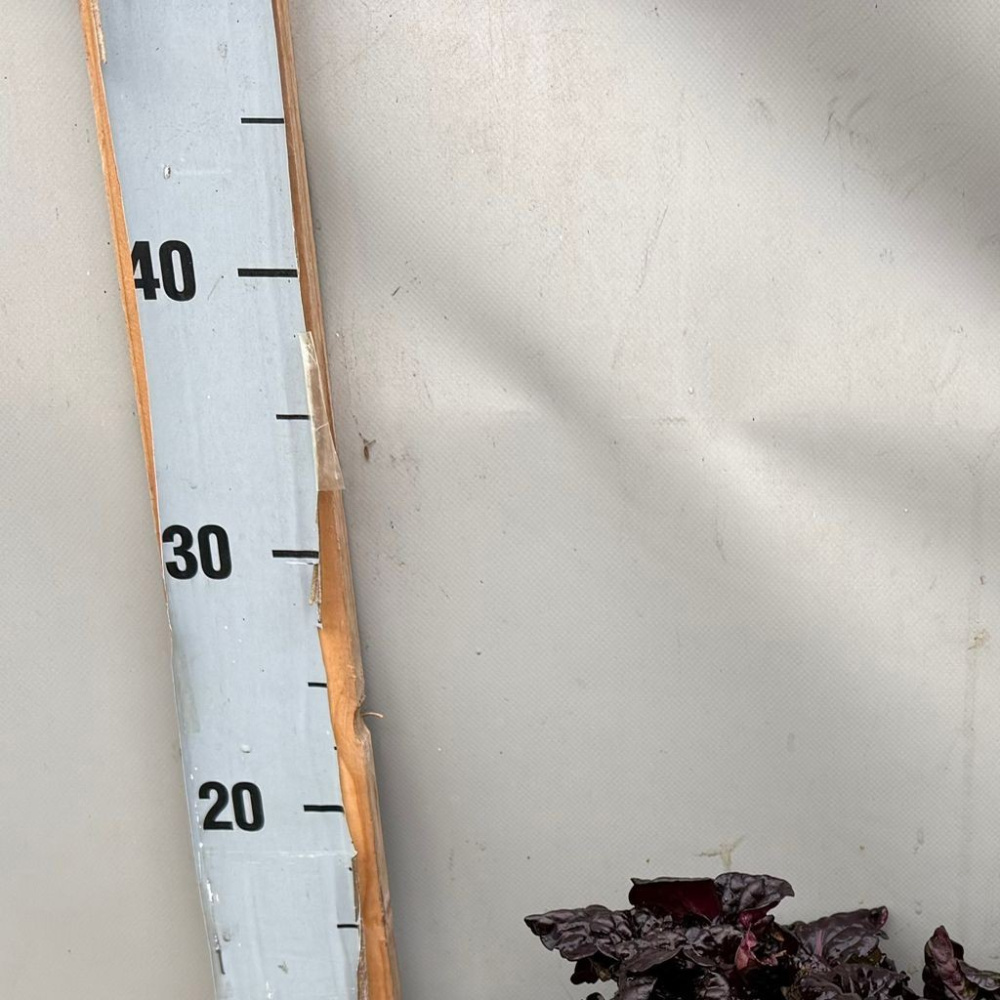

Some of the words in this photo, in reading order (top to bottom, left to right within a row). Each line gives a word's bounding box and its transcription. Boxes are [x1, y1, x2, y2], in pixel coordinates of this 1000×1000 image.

[131, 239, 197, 302] 40
[161, 524, 233, 580] 30
[198, 780, 266, 832] 20
